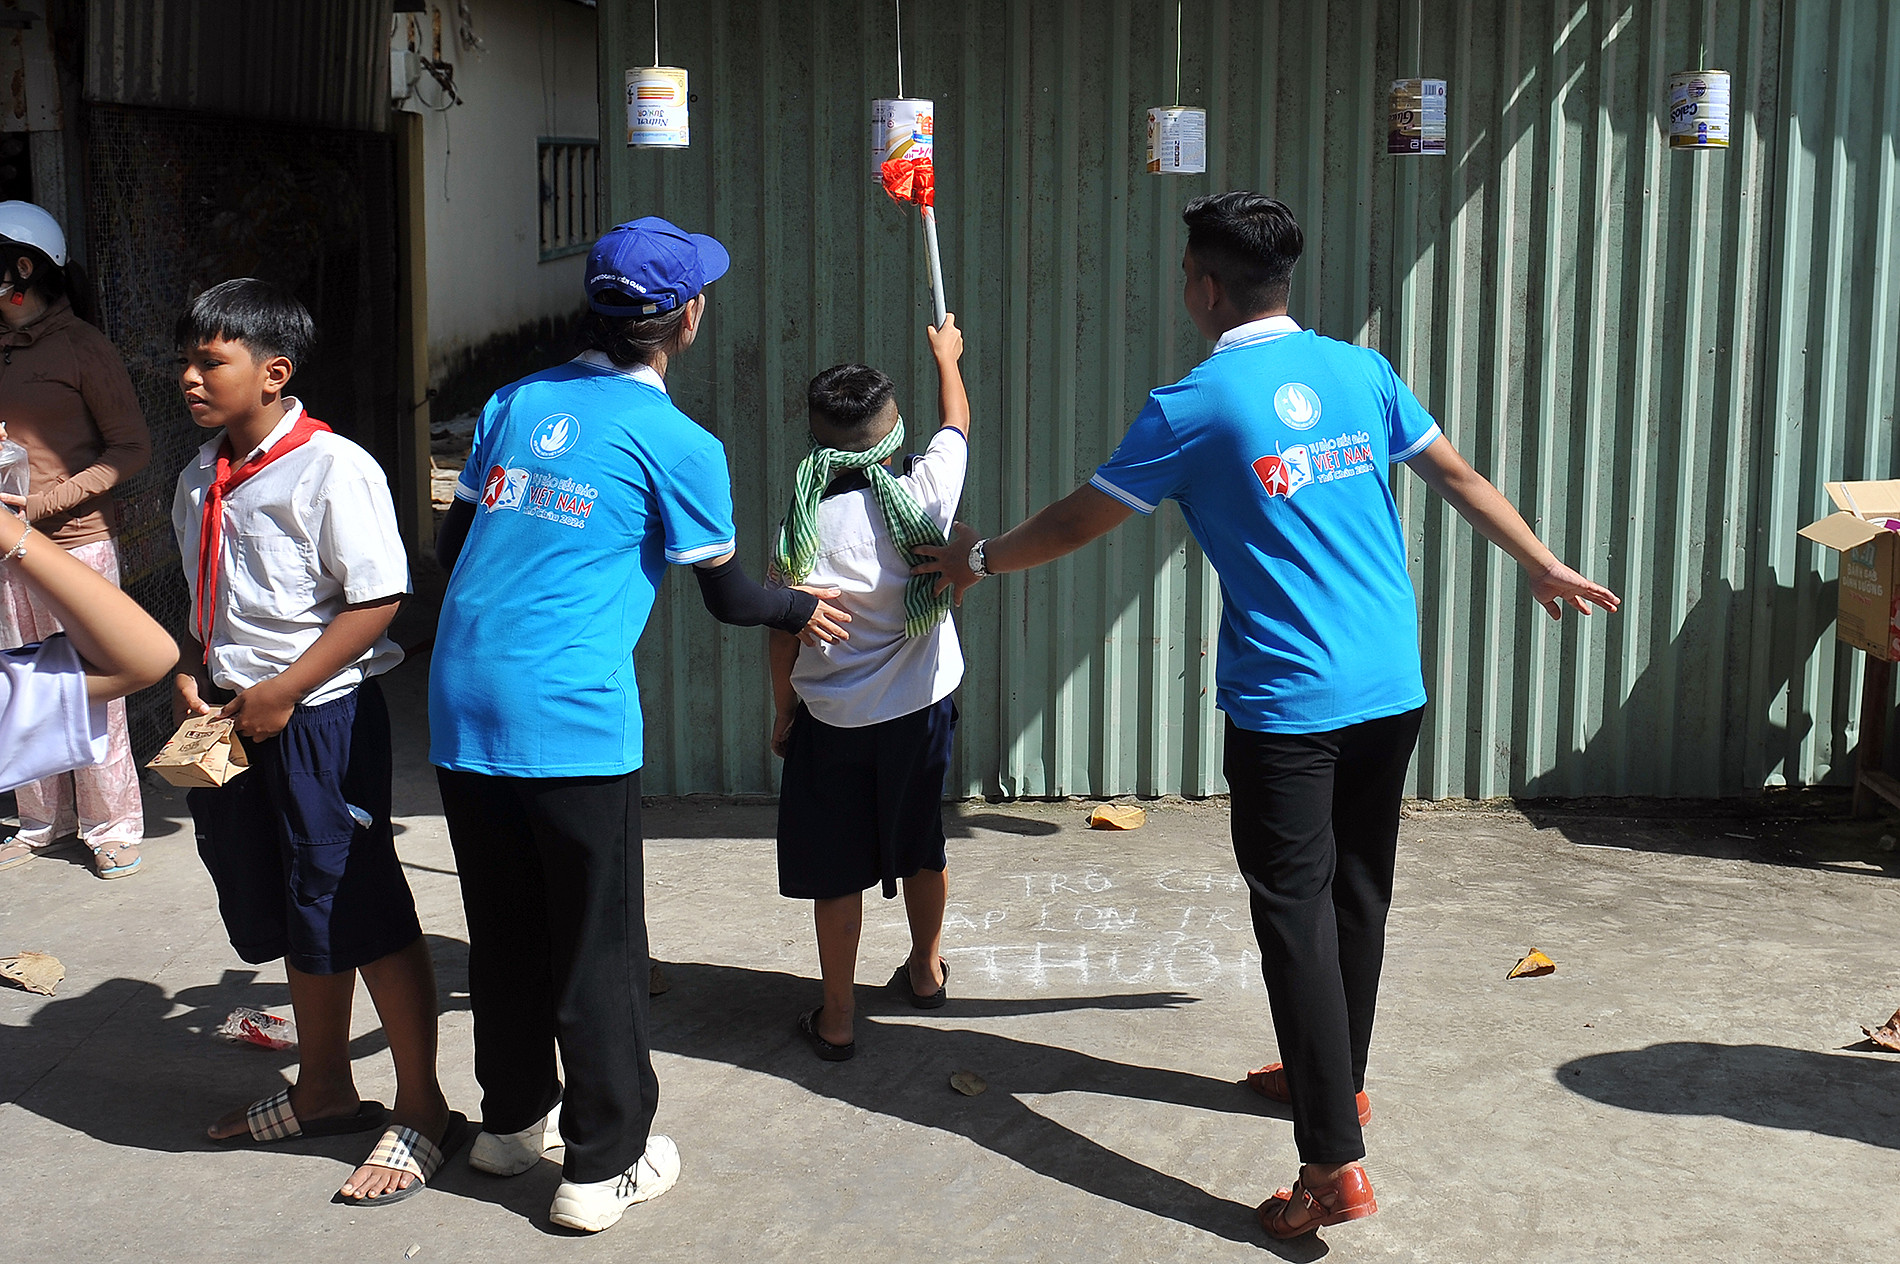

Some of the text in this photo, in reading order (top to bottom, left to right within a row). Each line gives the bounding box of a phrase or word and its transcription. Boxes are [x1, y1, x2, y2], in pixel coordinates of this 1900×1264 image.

[637, 109, 664, 117] JUNIOR
[637, 118, 668, 126] Nutren
[1312, 444, 1373, 473] VIỆT NAM
[529, 486, 594, 518] VIỆT NAM
[1156, 869, 1240, 893] CH
[1171, 905, 1244, 931] TR
